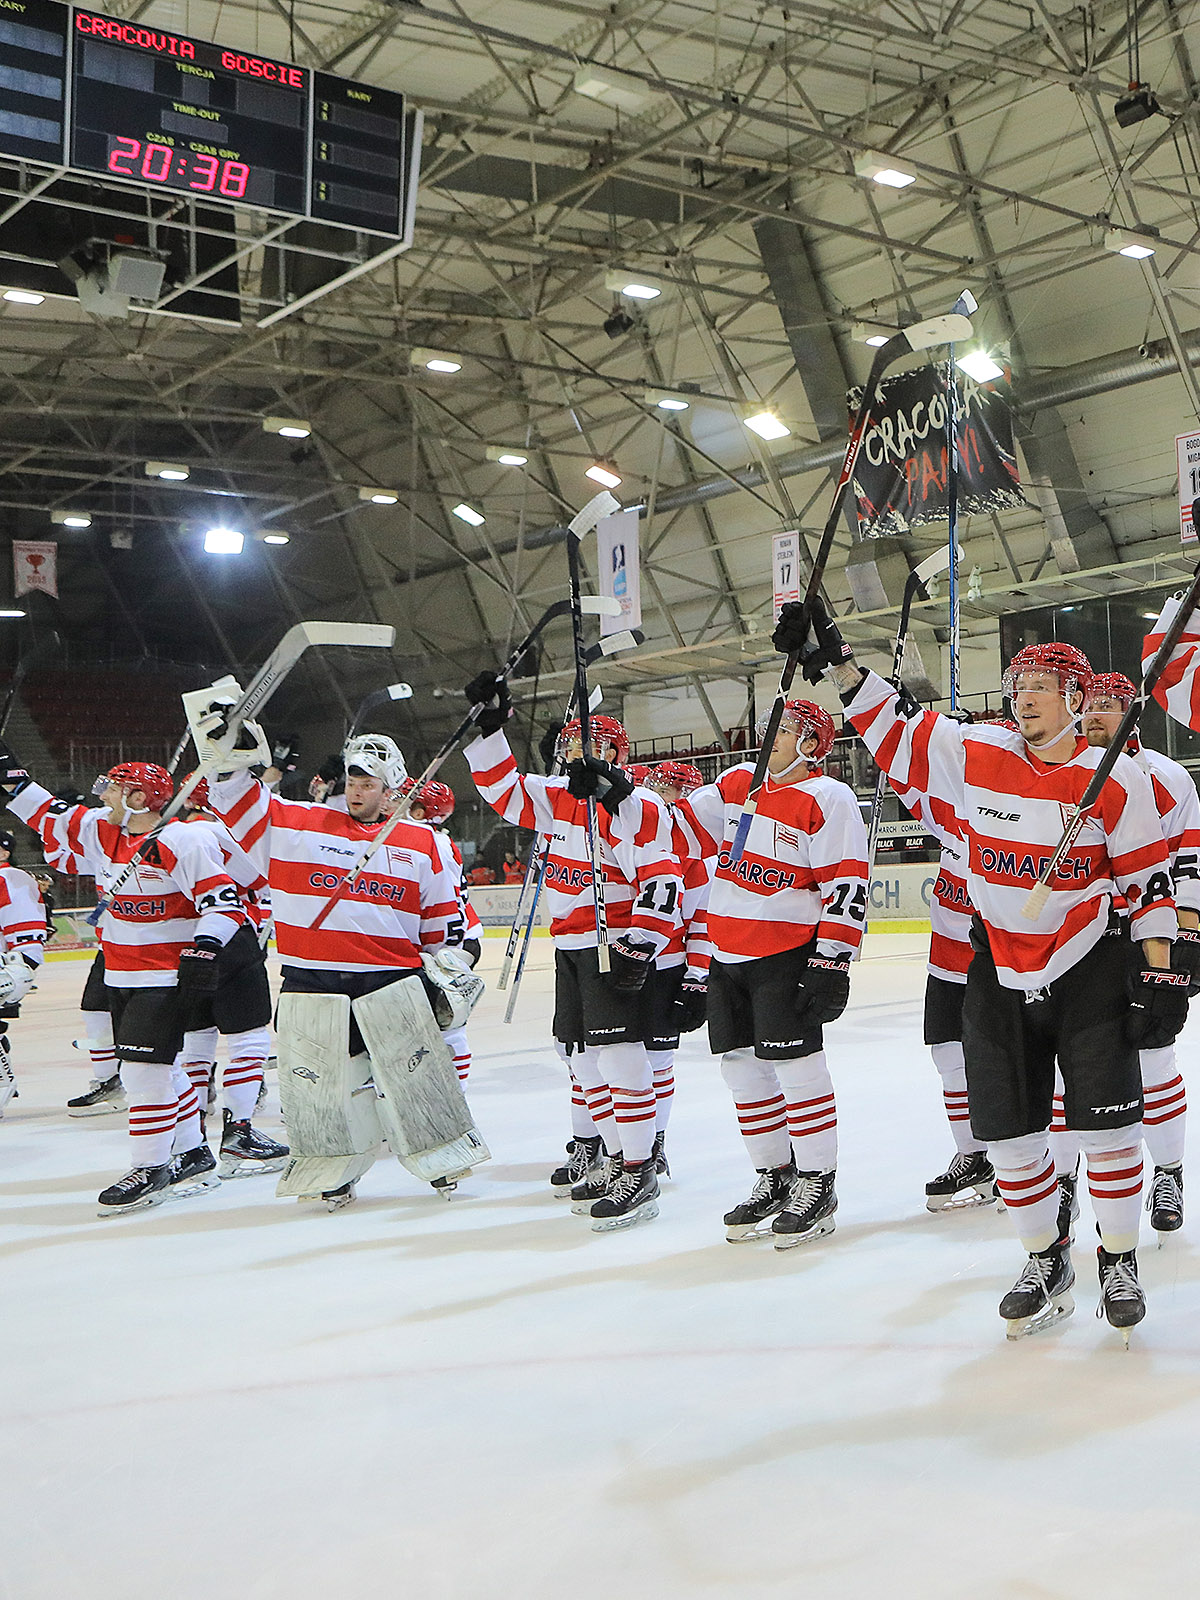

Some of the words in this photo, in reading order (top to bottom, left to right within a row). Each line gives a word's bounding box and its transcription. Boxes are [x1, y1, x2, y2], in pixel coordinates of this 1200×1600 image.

[0, 0, 27, 13] ARY
[75, 13, 196, 60] CRACOVIA
[221, 51, 304, 89] GOSCIE
[175, 62, 216, 81] TERCJA
[346, 88, 372, 103] KARY
[172, 102, 221, 122] TIME-OUT
[146, 131, 175, 147] CZAS
[189, 142, 219, 158] CZAS
[217, 149, 241, 162] GRY
[107, 135, 251, 199] 20:38
[864, 376, 985, 467] CRACOA
[843, 439, 859, 475] TRUE
[780, 562, 792, 586] 17
[976, 806, 1021, 823] TRUE
[318, 844, 355, 857] TRUE
[877, 839, 894, 849] BLACK
[905, 837, 924, 847] BLACK
[717, 849, 795, 889] OARCH
[976, 844, 1092, 881] OMACH
[309, 871, 407, 902] COARCH
[637, 880, 678, 915] 11
[112, 900, 166, 916] ARCH
[180, 948, 217, 961] RUE
[1140, 970, 1191, 985] TRU
[588, 1026, 627, 1036] TRUE
[760, 1038, 805, 1049] TRUE
[1090, 1099, 1140, 1115] TRUE
